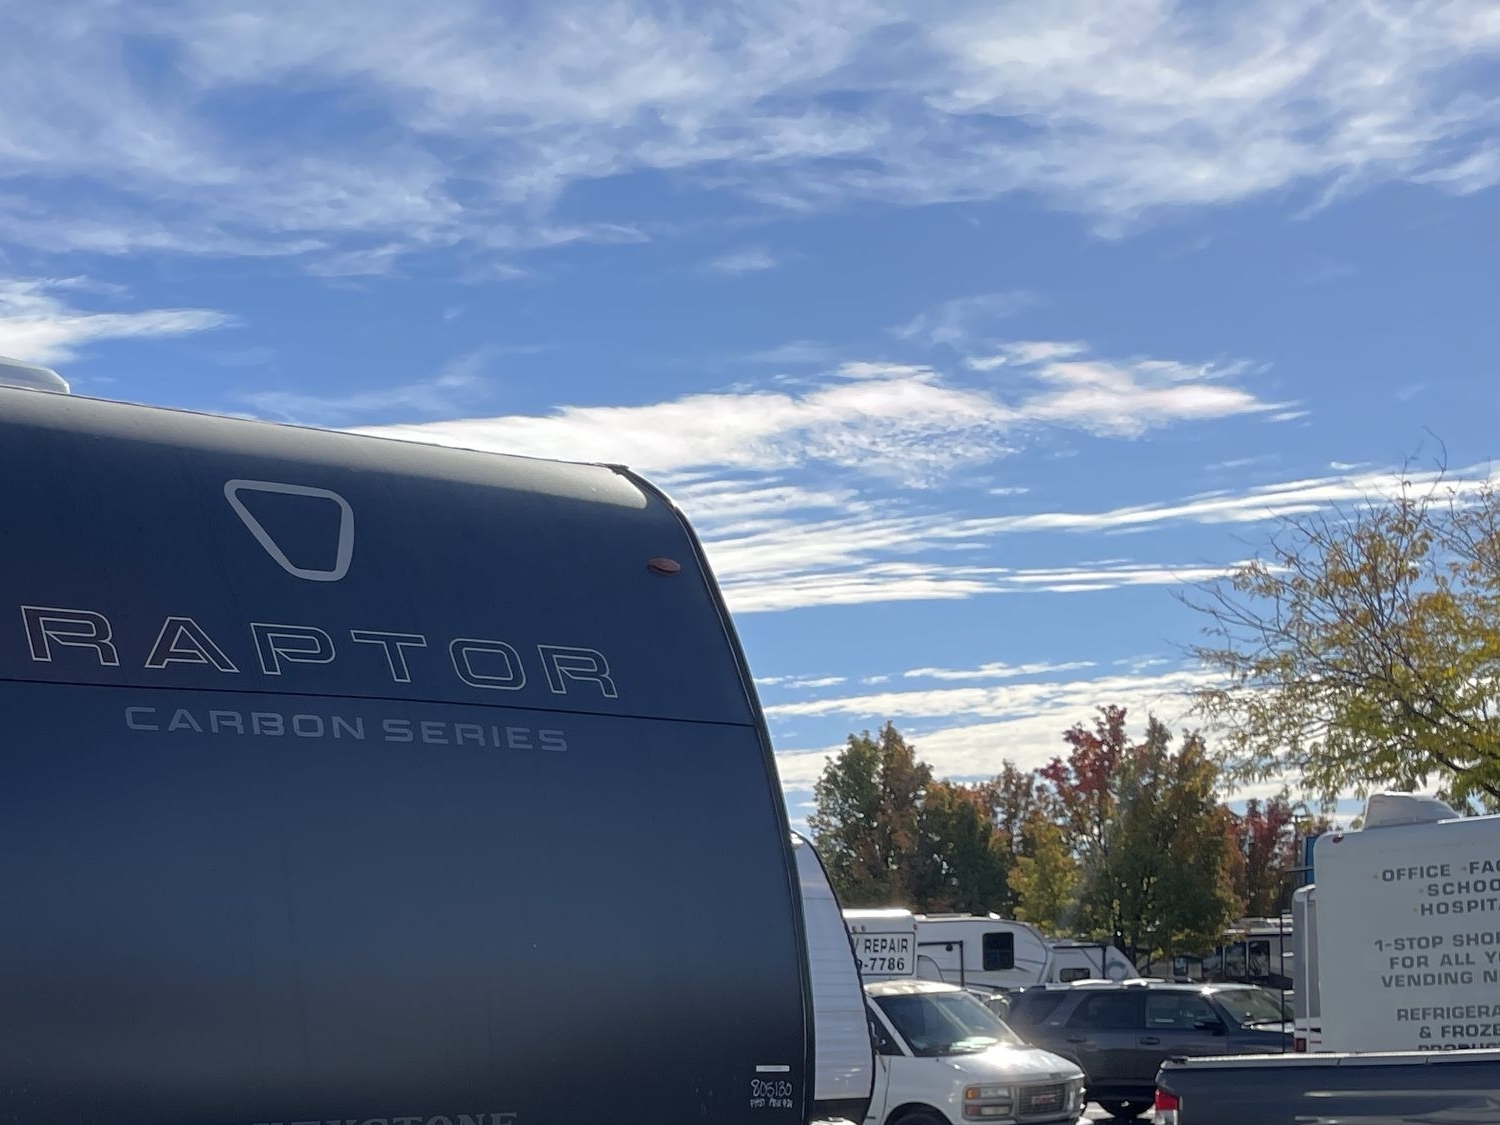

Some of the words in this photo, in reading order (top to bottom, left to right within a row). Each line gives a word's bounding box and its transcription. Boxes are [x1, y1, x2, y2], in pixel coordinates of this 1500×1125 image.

[21, 605, 618, 698] RAPTOR
[125, 706, 365, 740] CARBON
[383, 718, 568, 752] SERIES
[1382, 864, 1451, 882] OFFICE
[1420, 898, 1500, 916] HOSPIT
[864, 938, 908, 953] REPAIR
[1374, 936, 1443, 951] 1-STOP
[1389, 955, 1429, 969] FOR
[1440, 953, 1475, 966] ALL
[1381, 971, 1473, 988] VENDING
[1419, 1026, 1431, 1038] &
